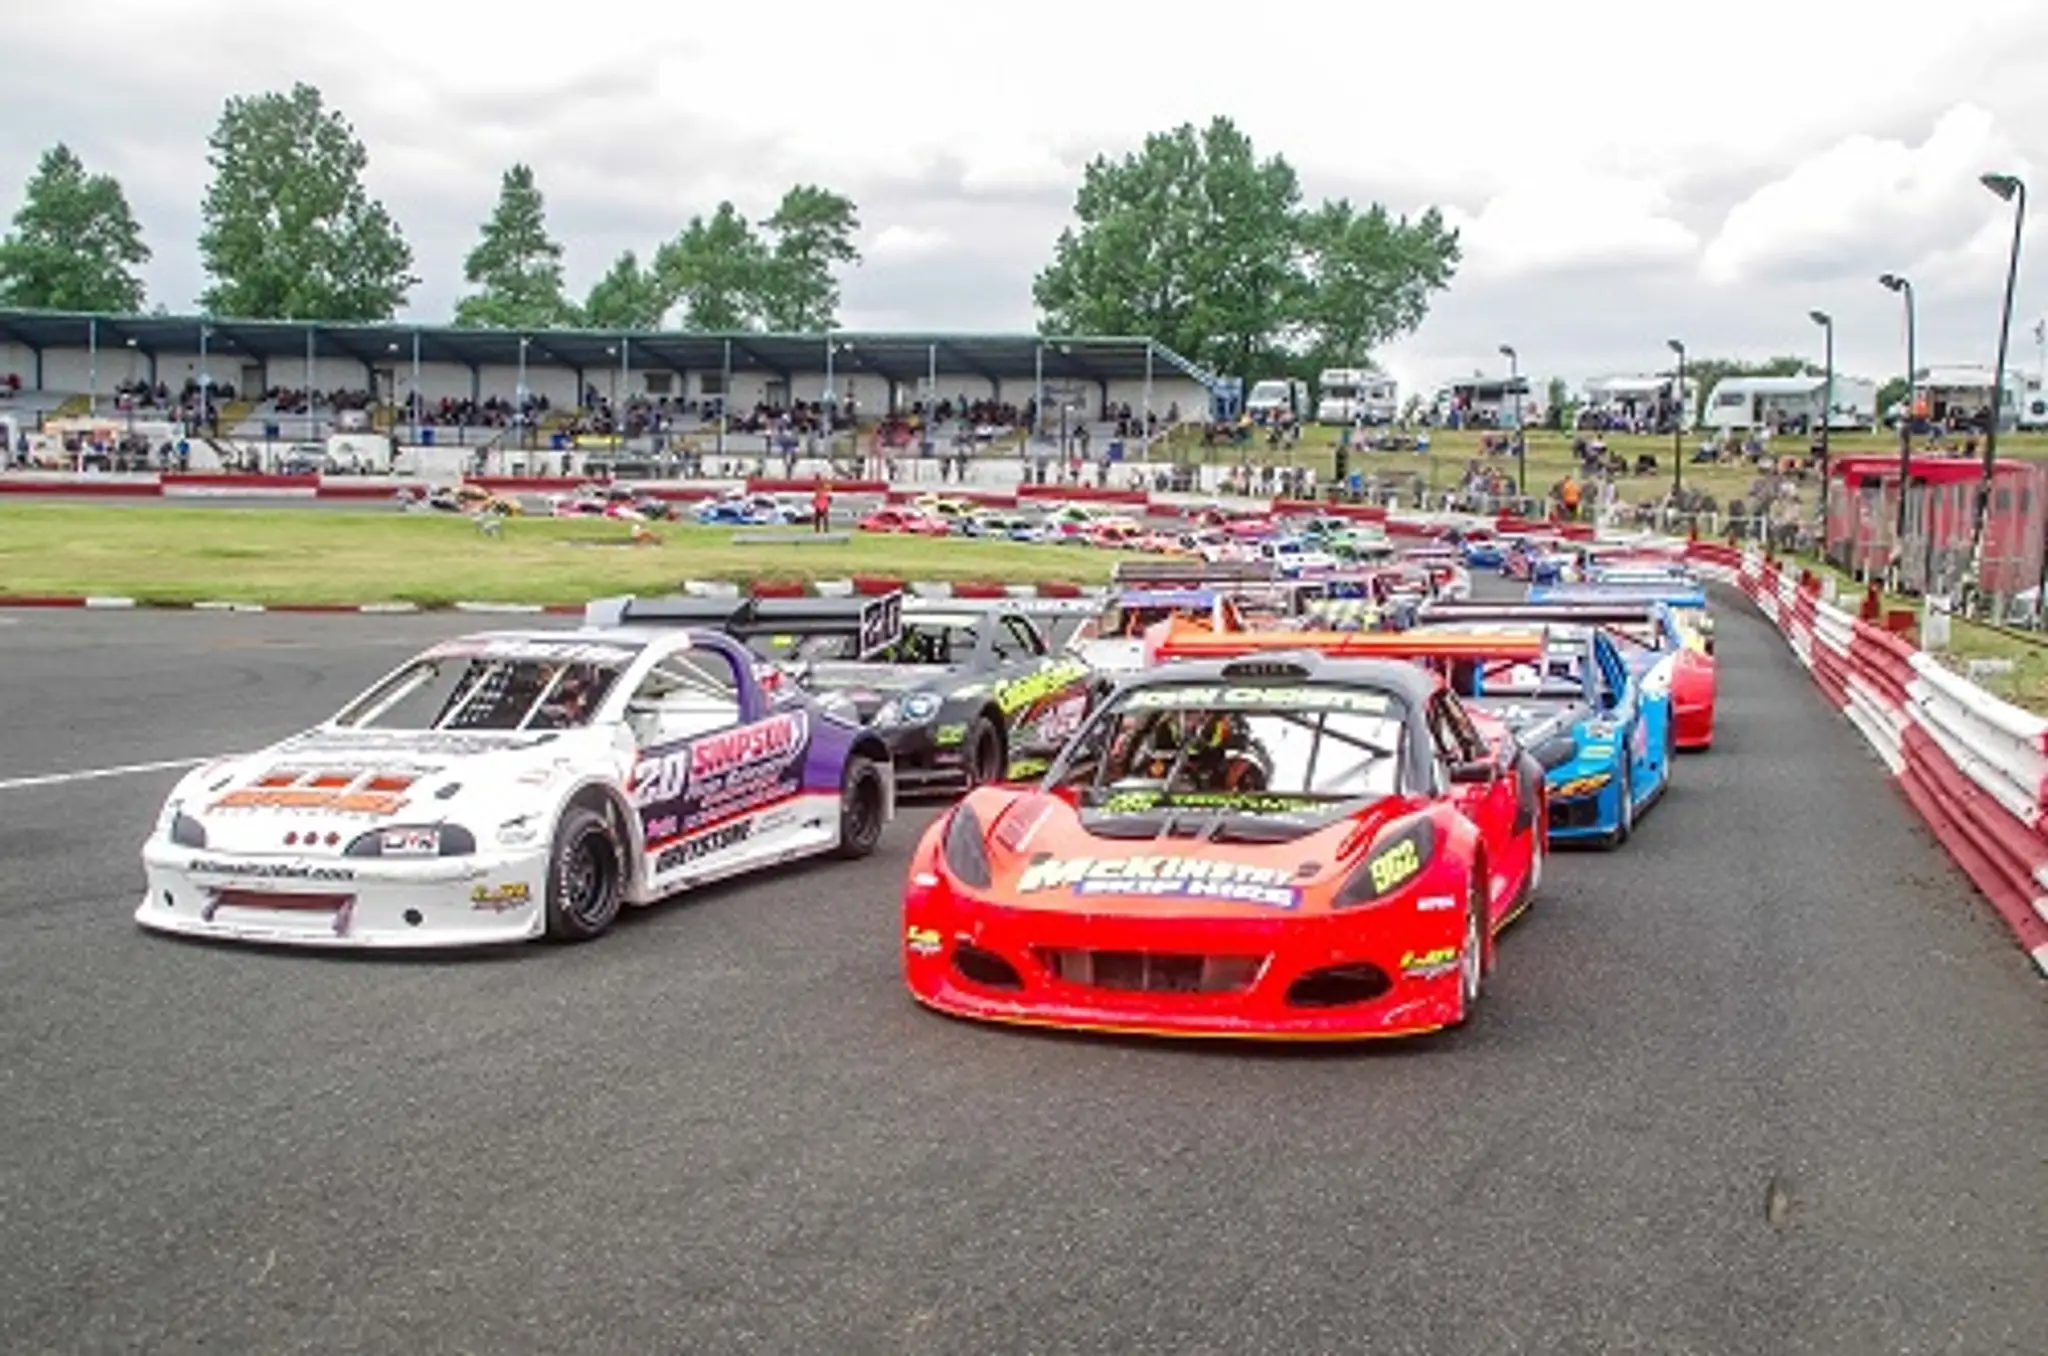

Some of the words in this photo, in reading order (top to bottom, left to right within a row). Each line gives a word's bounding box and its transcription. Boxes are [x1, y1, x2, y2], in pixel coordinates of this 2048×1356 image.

[865, 599, 901, 649] 20
[692, 715, 793, 776] SIMPSON
[630, 752, 688, 807] 20
